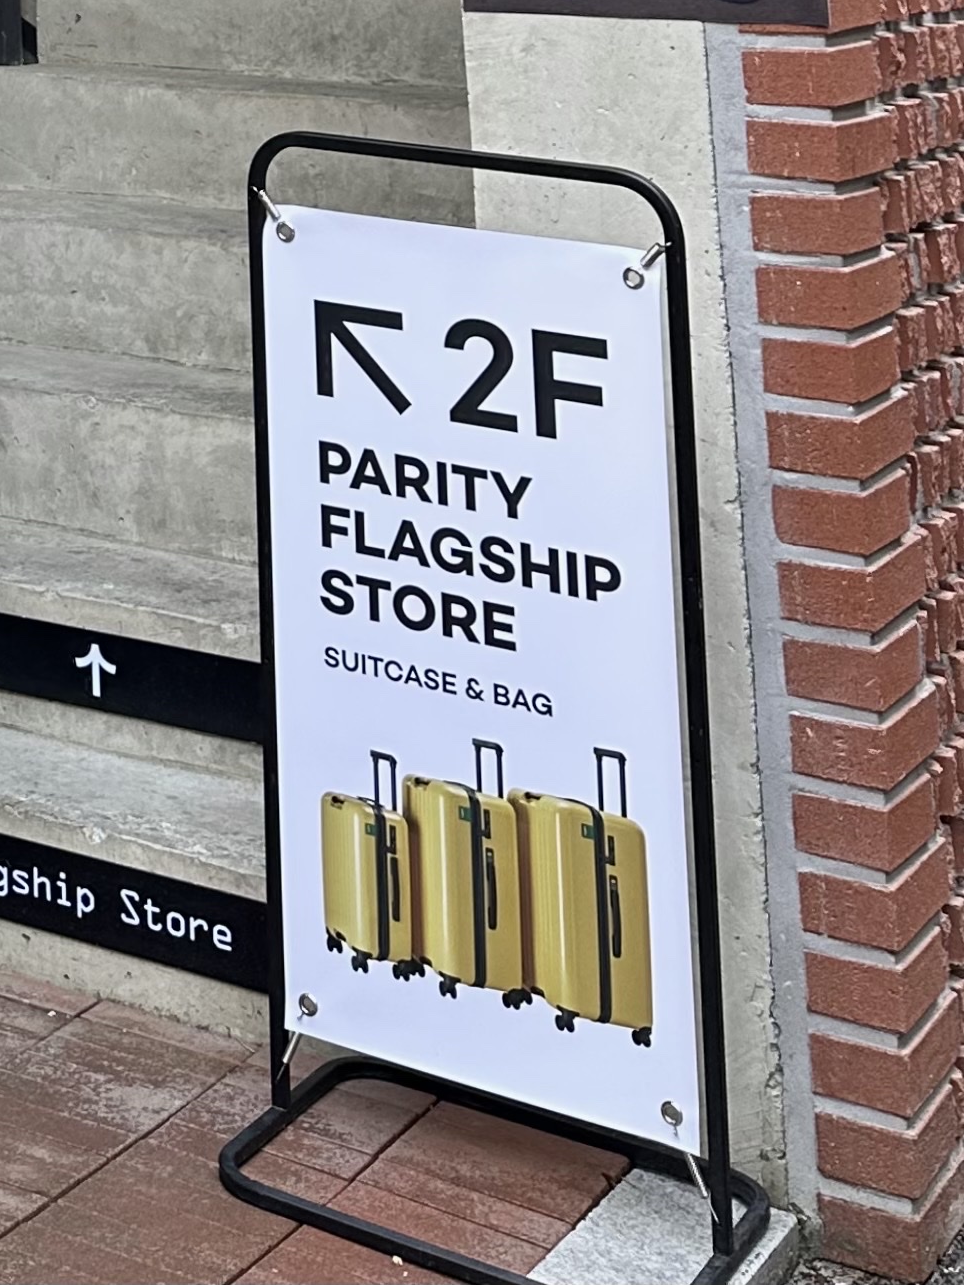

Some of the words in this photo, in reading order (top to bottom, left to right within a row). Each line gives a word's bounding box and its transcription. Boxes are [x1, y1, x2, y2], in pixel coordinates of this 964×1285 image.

[444, 318, 608, 439] 2F
[318, 439, 533, 520] PARITY
[320, 503, 622, 602] FLAGSHIP
[319, 569, 517, 652] STORE
[323, 646, 457, 696] SUITCASE
[465, 678, 484, 701] &
[493, 685, 554, 716] BAG
[120, 888, 234, 953] Store
